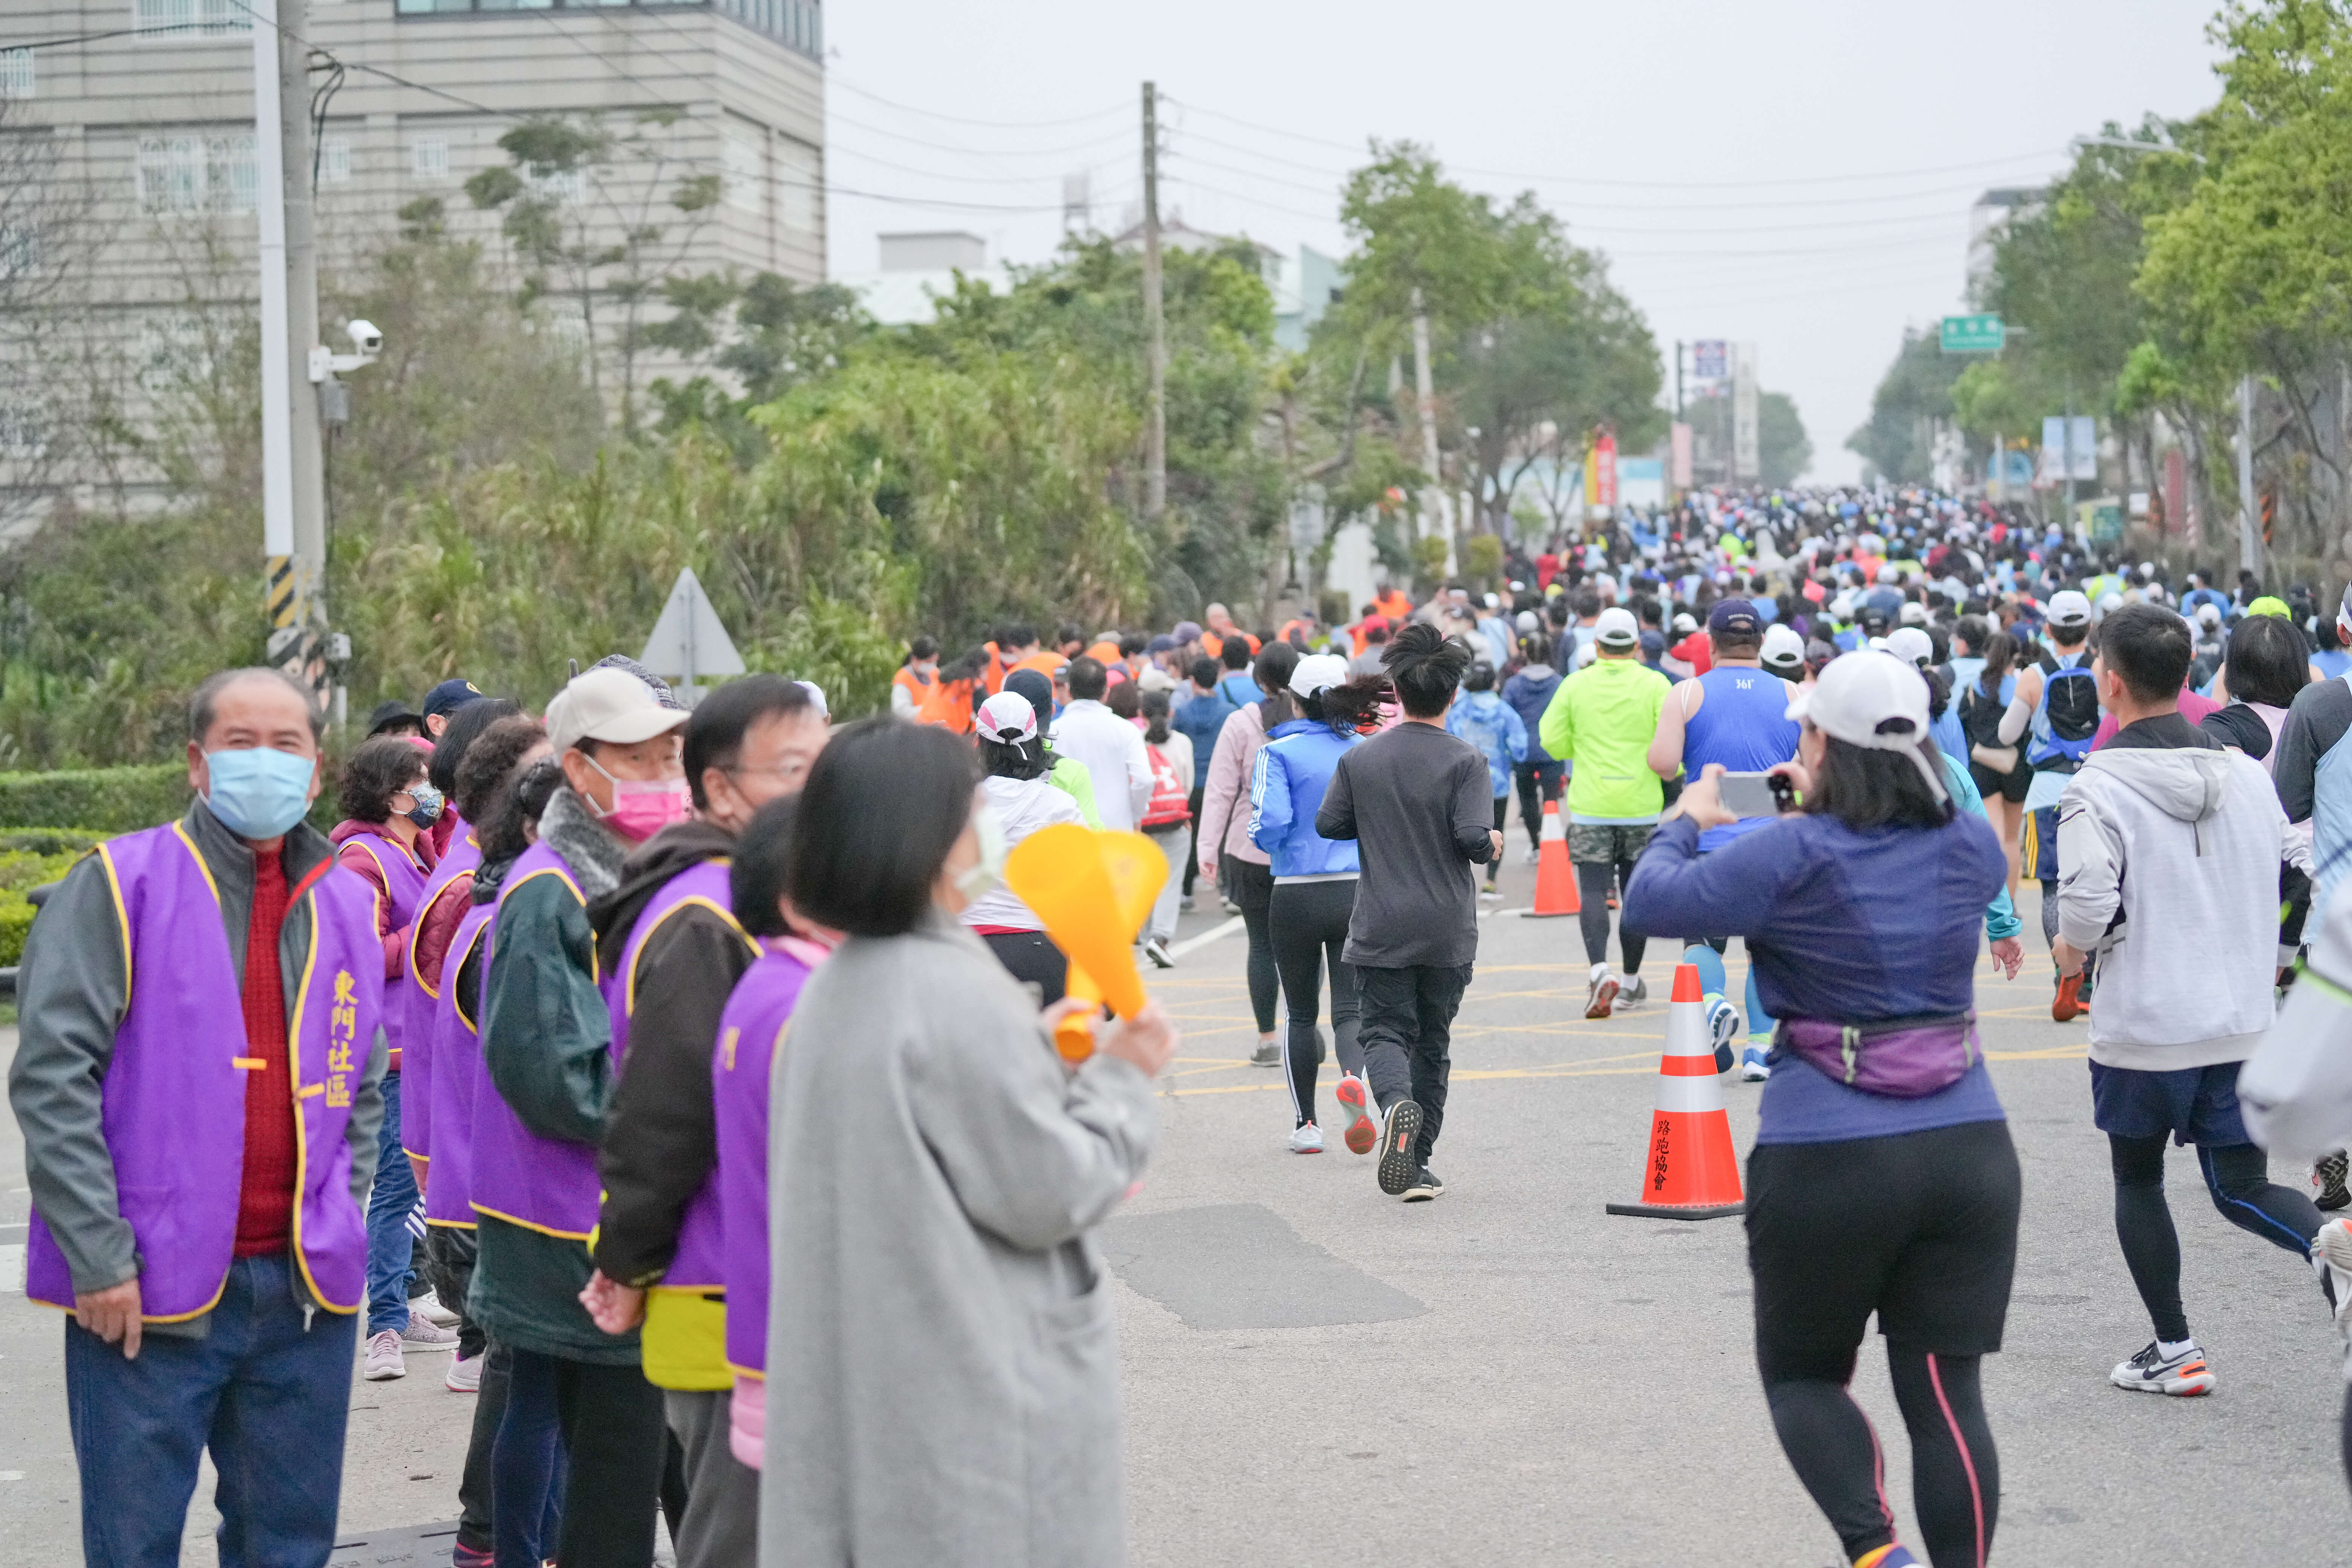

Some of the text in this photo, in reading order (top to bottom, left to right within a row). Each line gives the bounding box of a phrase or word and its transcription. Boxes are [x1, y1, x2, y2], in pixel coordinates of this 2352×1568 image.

[326, 969, 359, 1107] 東門社區
[1654, 1119, 1671, 1191] 路跑協會
